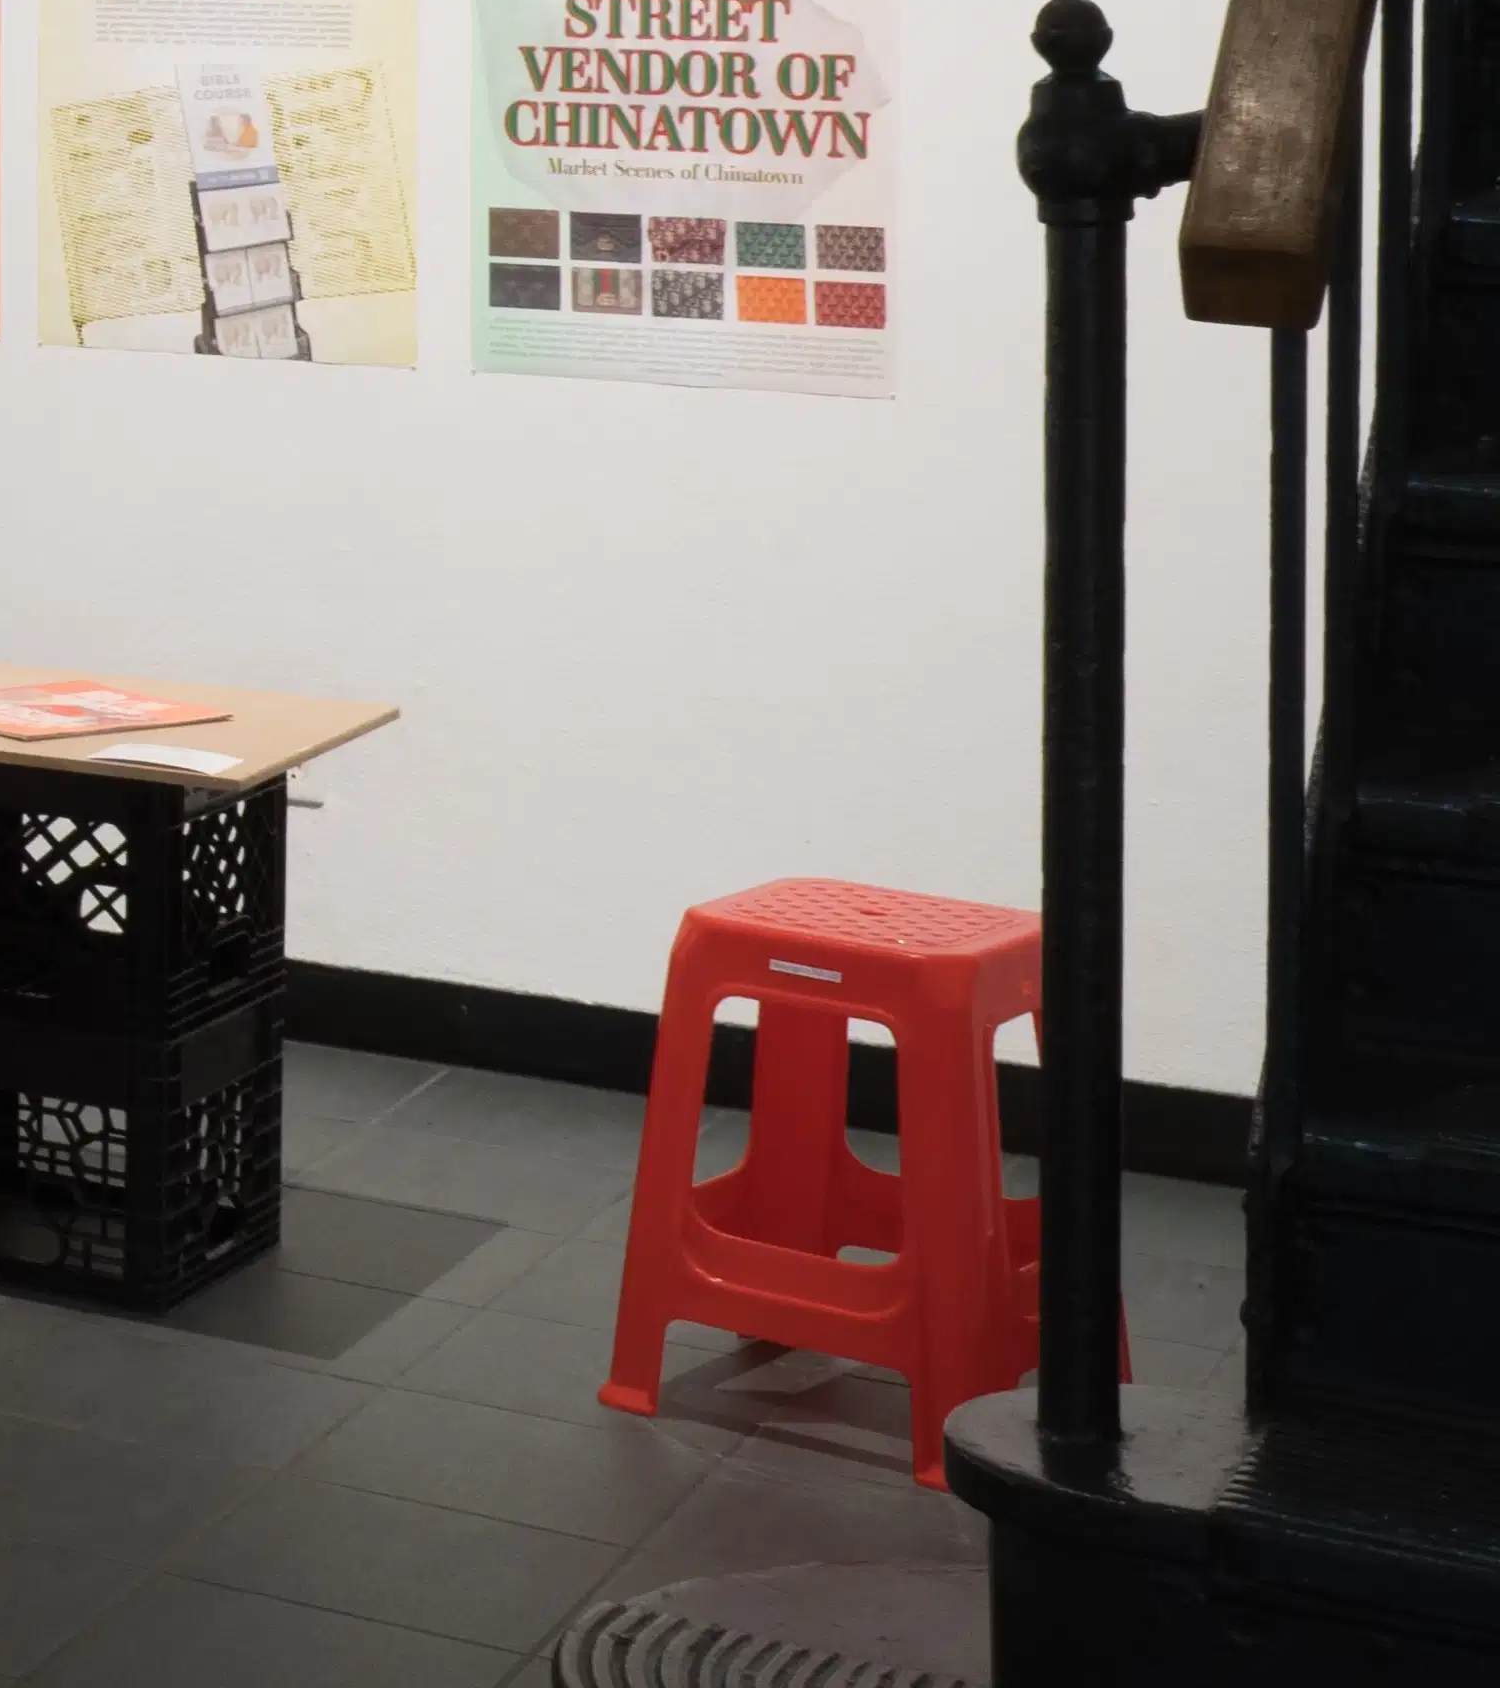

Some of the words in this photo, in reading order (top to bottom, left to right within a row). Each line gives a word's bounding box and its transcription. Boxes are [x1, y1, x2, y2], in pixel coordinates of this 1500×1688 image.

[518, 45, 760, 99] VENDOR
[776, 52, 856, 101] OF
[504, 100, 872, 160] CHINATOWN
[547, 157, 608, 177] Market
[614, 160, 675, 180] Scenes
[681, 162, 700, 179] of
[705, 164, 804, 185] Chinatown
